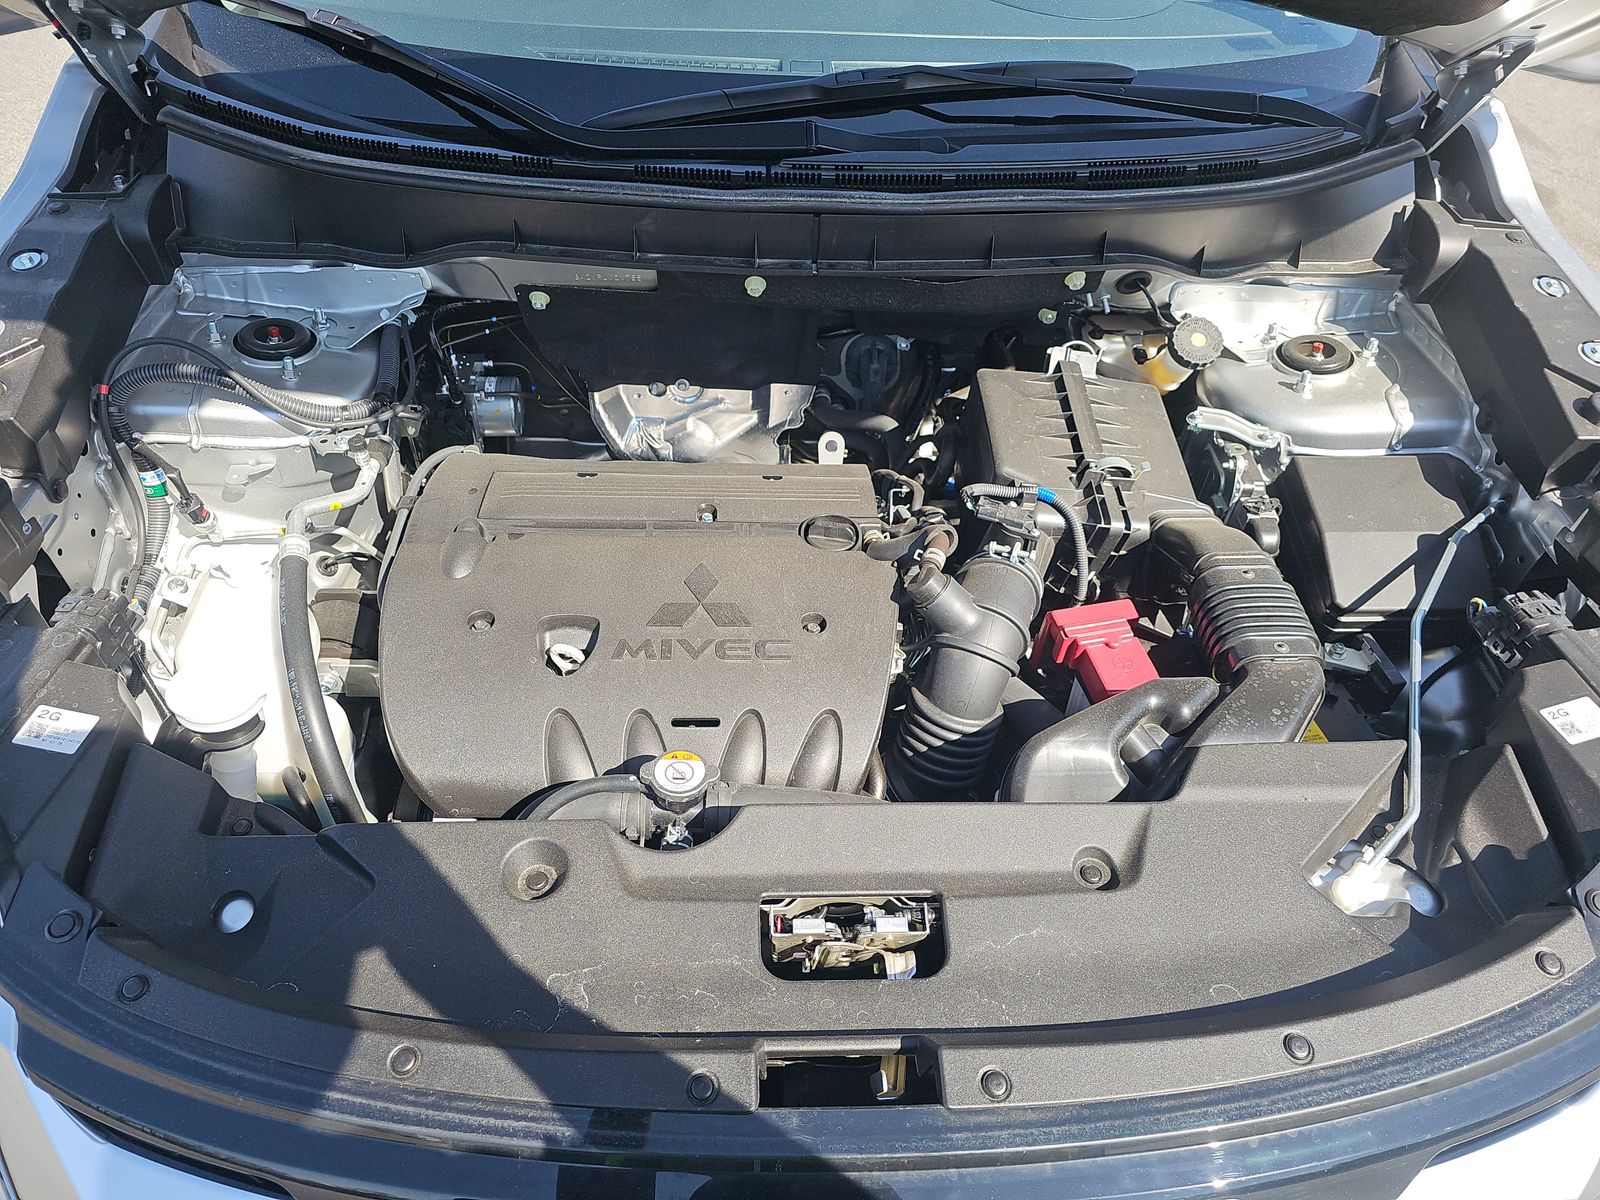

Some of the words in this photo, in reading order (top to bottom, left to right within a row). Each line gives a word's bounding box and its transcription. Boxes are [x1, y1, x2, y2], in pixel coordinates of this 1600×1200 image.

[611, 639, 791, 660] MIVEC
[37, 709, 62, 721] 2G
[1548, 708, 1570, 720] 2G
